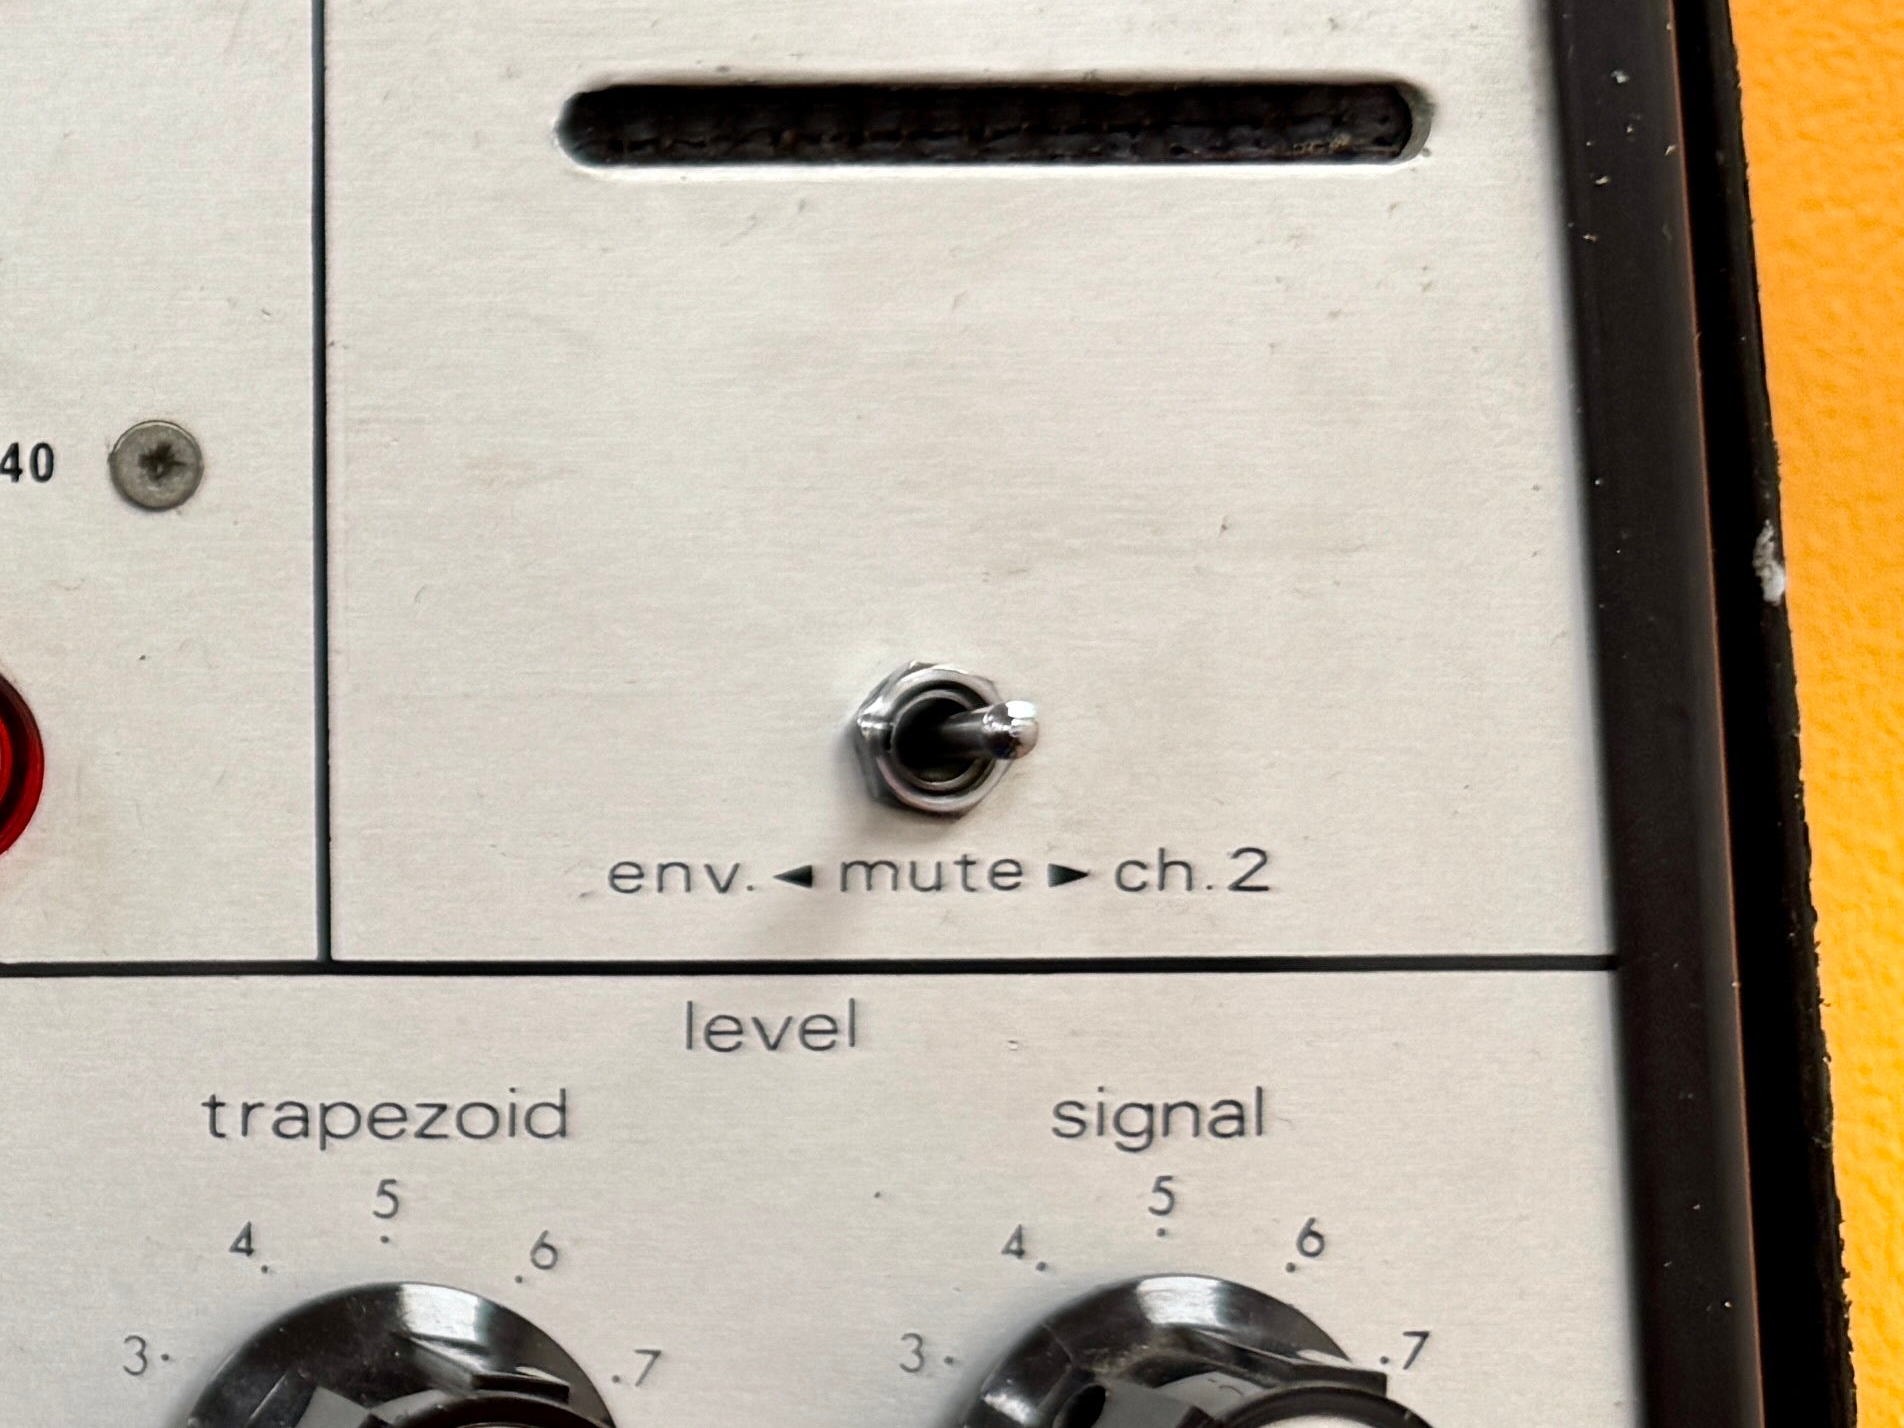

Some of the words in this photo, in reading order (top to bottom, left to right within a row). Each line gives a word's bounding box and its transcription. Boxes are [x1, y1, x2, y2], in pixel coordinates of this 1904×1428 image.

[608, 861, 756, 895] env.
[840, 853, 1030, 894] mute
[686, 998, 860, 1053] level
[201, 1087, 572, 1152] trapezoid
[1052, 1085, 1268, 1155] signal
[1148, 1175, 1180, 1217] 5
[229, 1221, 257, 1259] 4
[1296, 1217, 1329, 1260] 6
[634, 1349, 664, 1387] 7
[899, 1333, 928, 1375] 3
